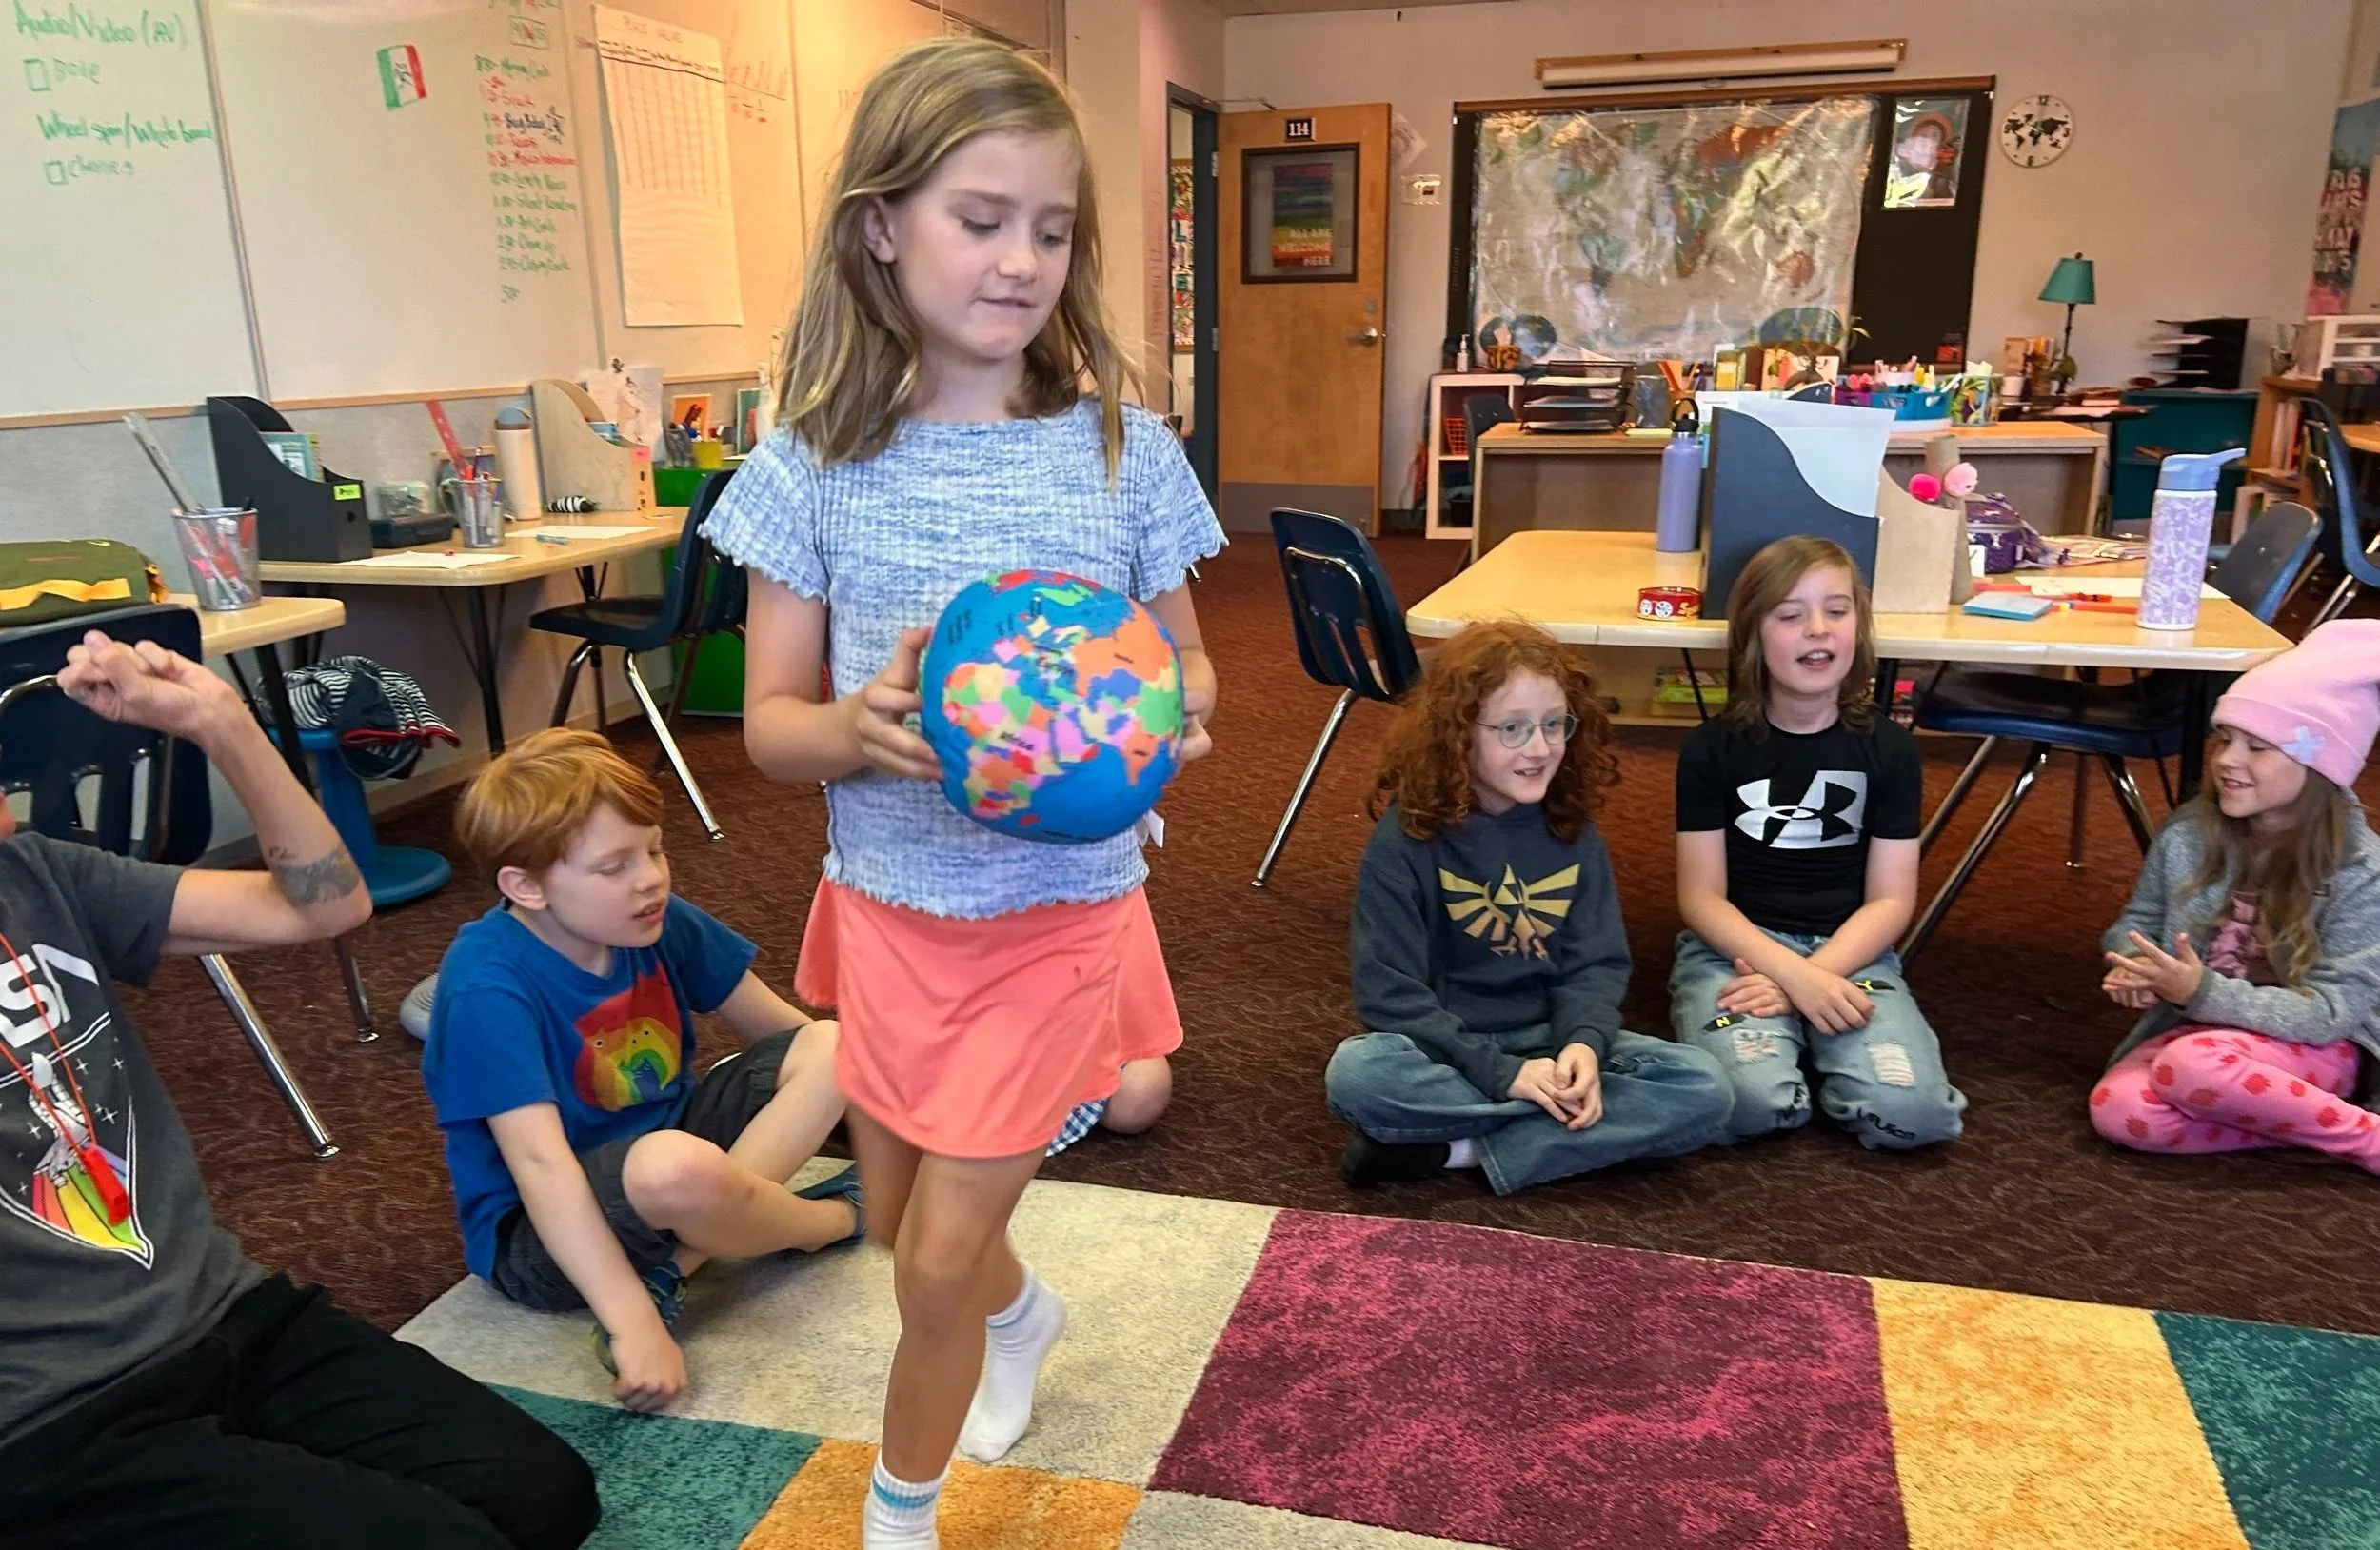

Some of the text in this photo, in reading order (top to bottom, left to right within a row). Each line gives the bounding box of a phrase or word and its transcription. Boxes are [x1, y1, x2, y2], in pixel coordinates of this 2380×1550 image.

[1288, 122, 1309, 136] 114
[1288, 228, 1331, 238] ALL ARE
[1278, 241, 1331, 253] WELCOME
[1302, 255, 1331, 267] HERE
[1716, 1016, 1731, 1027] N
